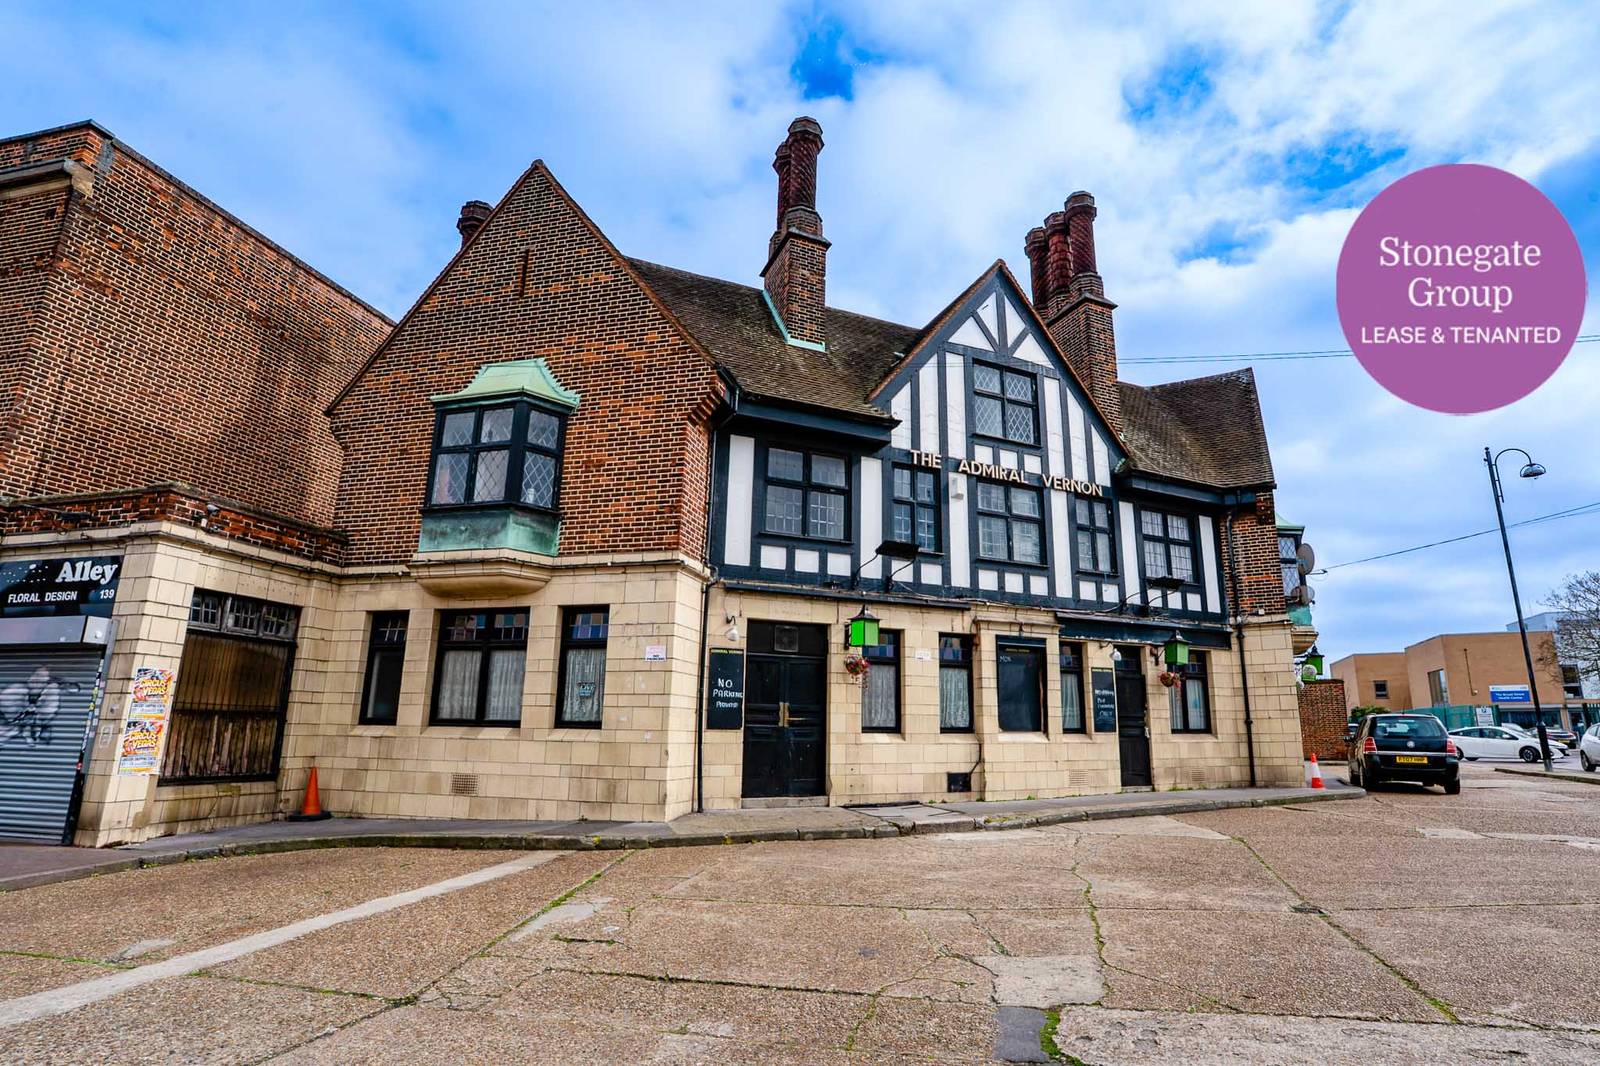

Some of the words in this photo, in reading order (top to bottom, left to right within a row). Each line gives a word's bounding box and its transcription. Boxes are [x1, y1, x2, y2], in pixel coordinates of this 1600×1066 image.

[910, 449, 942, 469] THE
[958, 459, 1029, 484] ADMIRAL
[1042, 473, 1104, 497] VERNON
[55, 560, 118, 585] Alley
[8, 592, 40, 603] FLORAL
[45, 591, 78, 602] DESIGN
[99, 588, 115, 599] 139
[718, 678, 733, 688] NO
